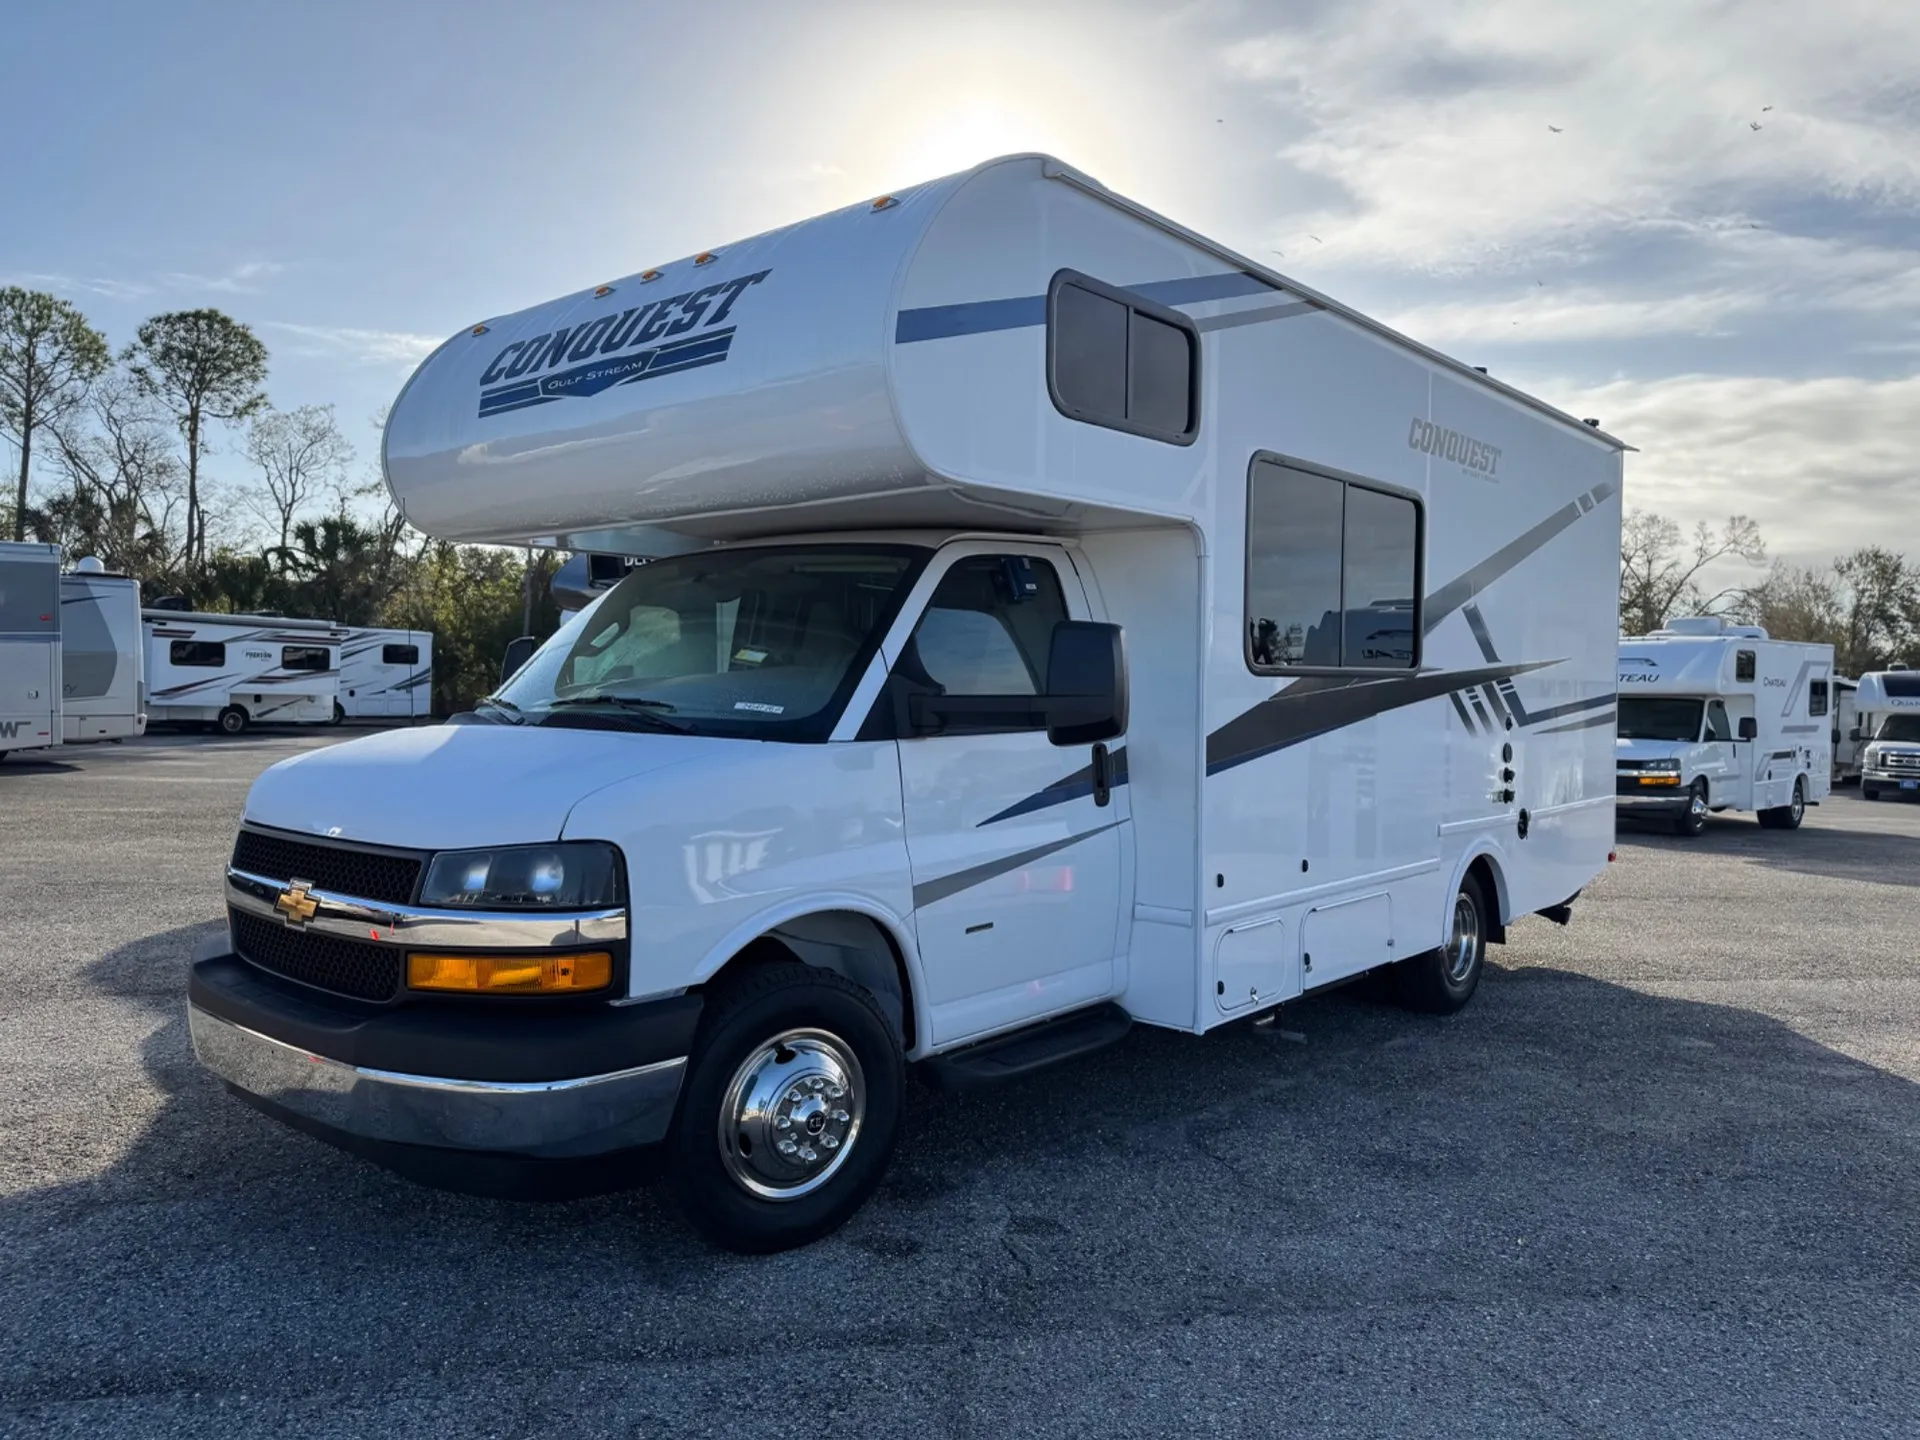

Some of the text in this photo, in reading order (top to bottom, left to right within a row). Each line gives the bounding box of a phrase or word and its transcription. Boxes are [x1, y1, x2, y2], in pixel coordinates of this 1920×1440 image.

[479, 268, 773, 386] CONQUEST
[548, 361, 642, 390] GULF STREAM
[1408, 417, 1502, 475] CONQUEST
